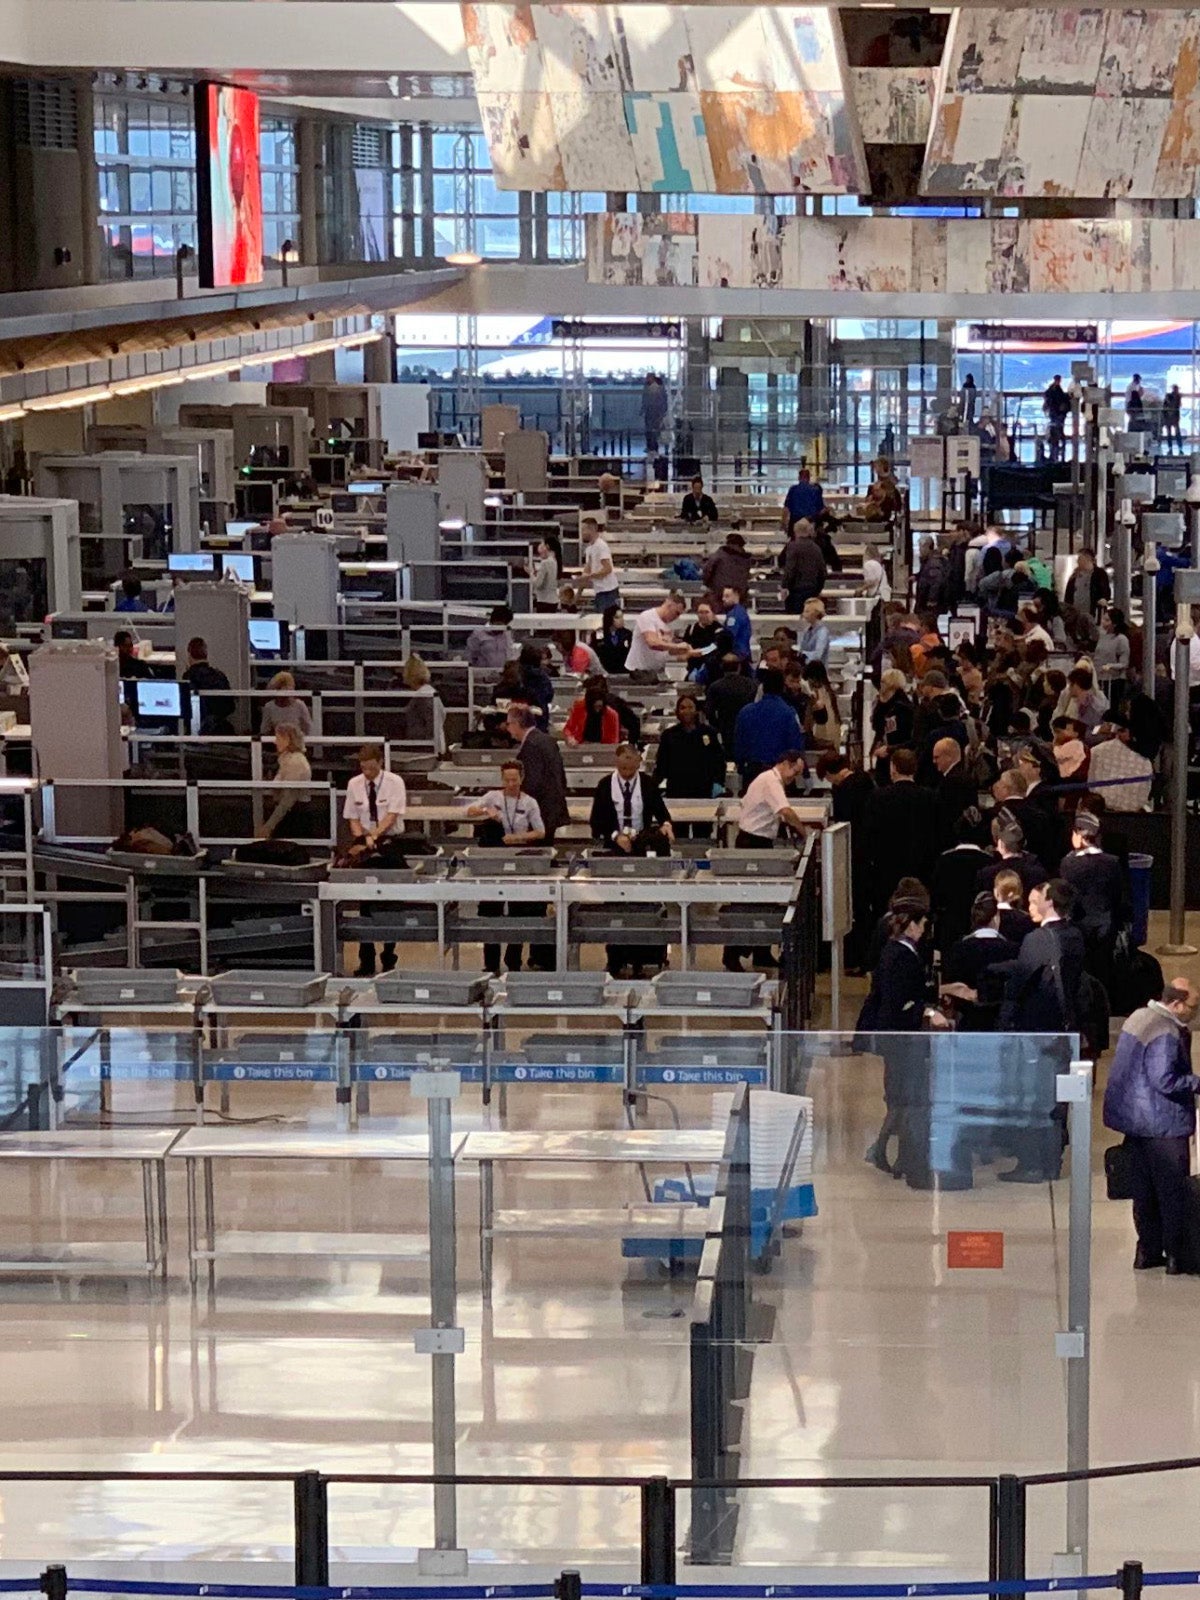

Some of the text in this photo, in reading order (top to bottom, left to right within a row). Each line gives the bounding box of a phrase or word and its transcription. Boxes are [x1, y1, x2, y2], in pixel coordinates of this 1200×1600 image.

[986, 330, 1008, 338] EXIT
[1022, 330, 1064, 340] Ticketing
[318, 514, 333, 524] 10
[152, 1066, 169, 1076] bin
[247, 1067, 271, 1078] Take
[274, 1067, 294, 1078] this
[296, 1067, 313, 1078] bin
[530, 1067, 553, 1080] Take
[556, 1067, 576, 1079] this
[578, 1067, 595, 1079] bin
[678, 1069, 701, 1082] Take
[703, 1069, 724, 1082] this
[725, 1070, 743, 1082] bin
